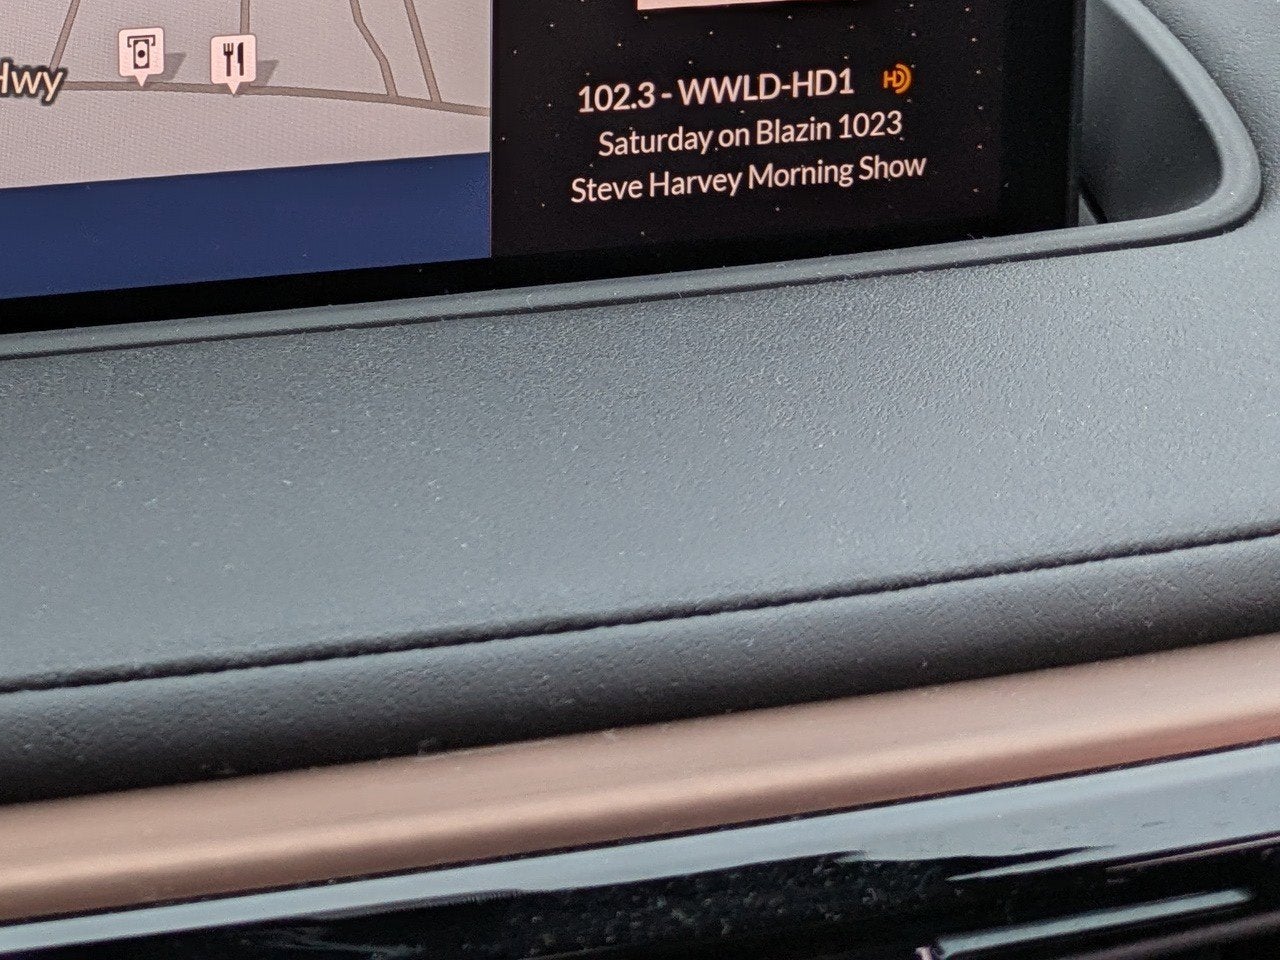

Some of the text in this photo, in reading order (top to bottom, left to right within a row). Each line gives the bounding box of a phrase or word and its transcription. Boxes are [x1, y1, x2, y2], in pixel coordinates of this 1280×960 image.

[578, 82, 656, 113] 102.3
[677, 68, 855, 106] WWLD-HD1
[598, 110, 903, 156] Saturday on Blazin 1023
[570, 155, 927, 203] Steve Harvey Morning Show
